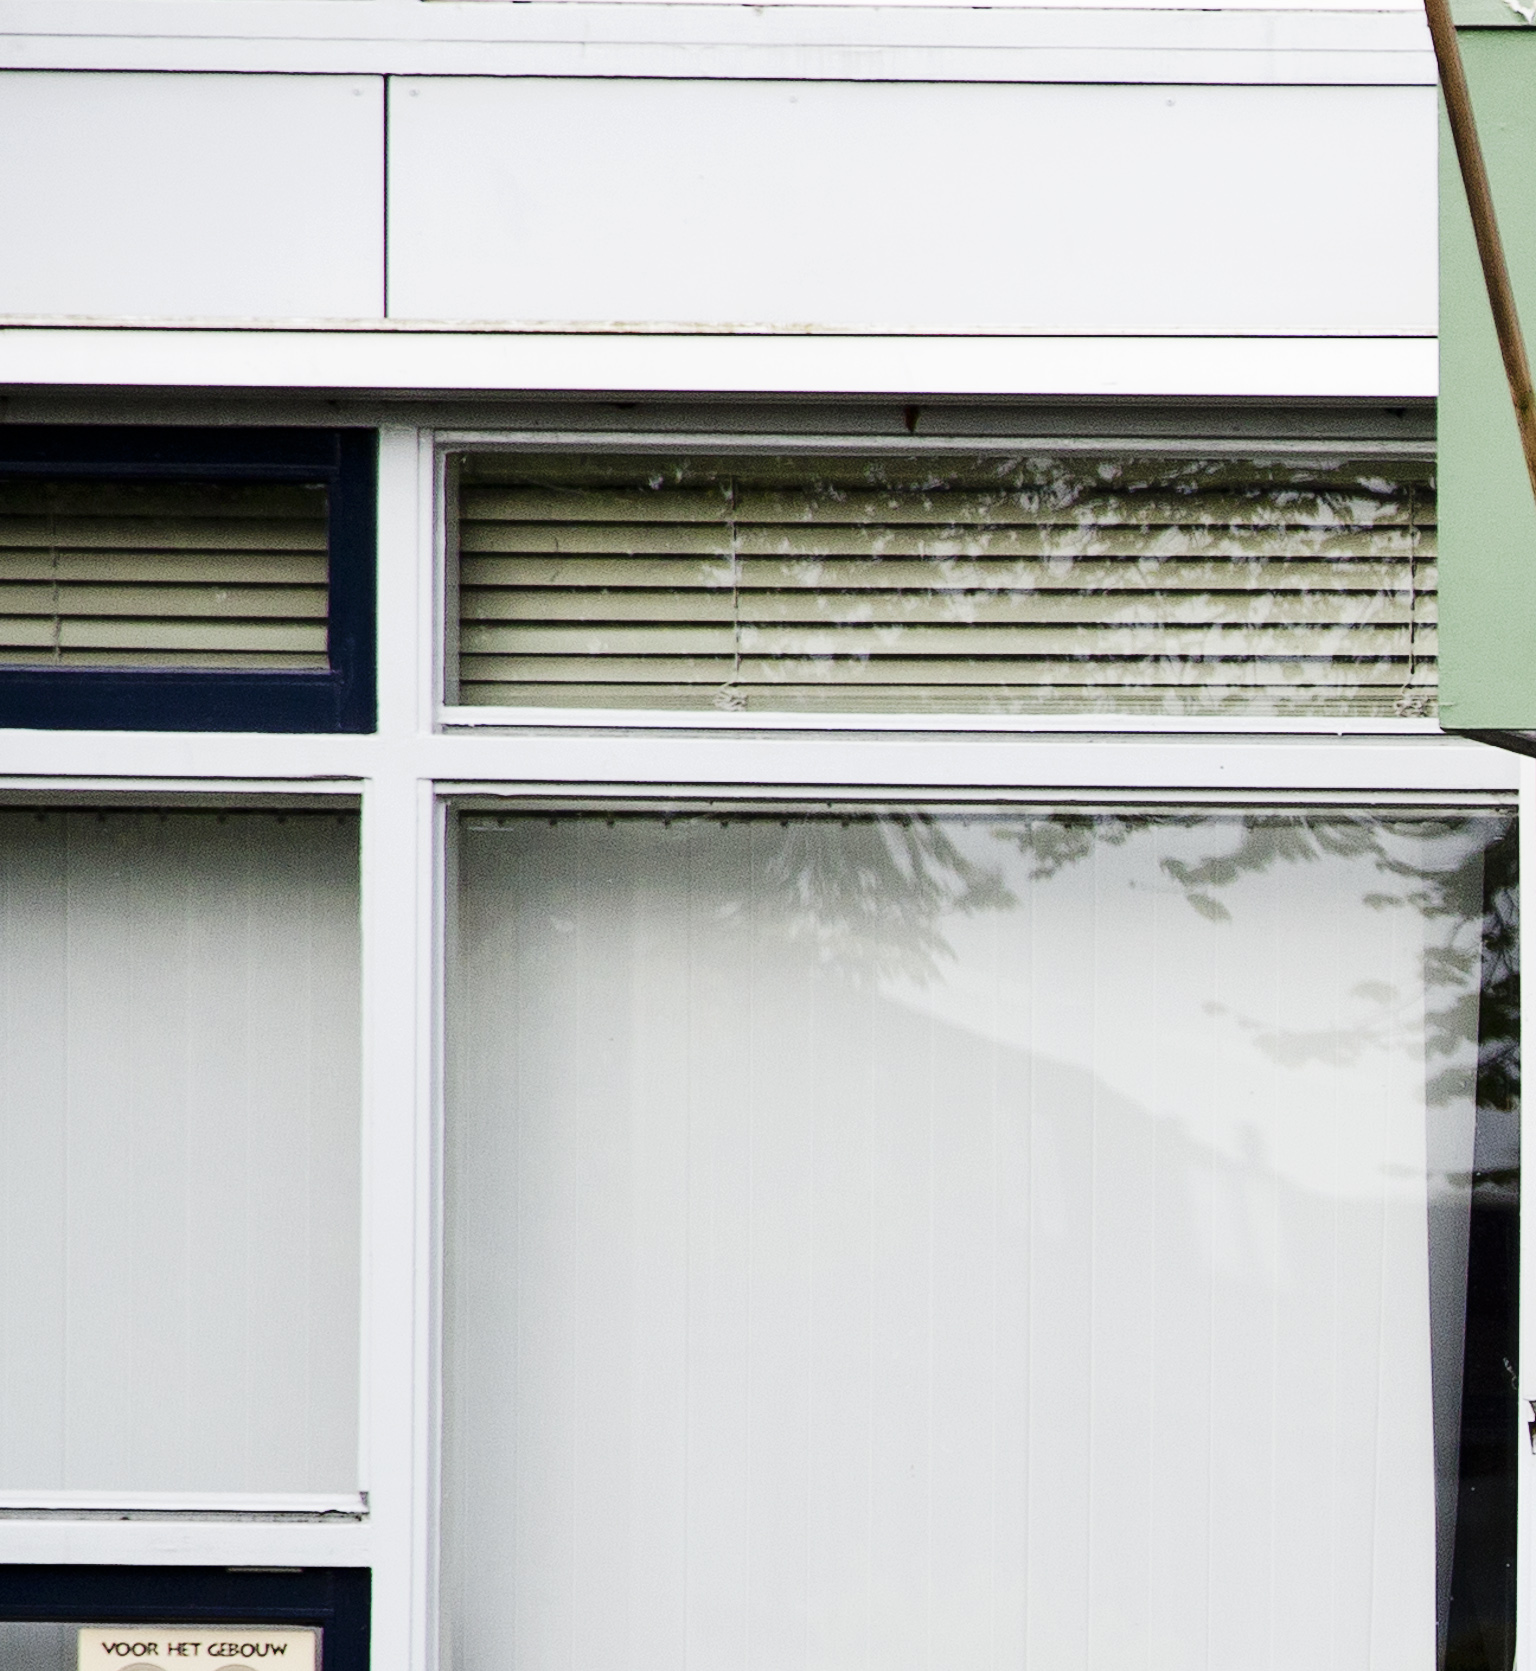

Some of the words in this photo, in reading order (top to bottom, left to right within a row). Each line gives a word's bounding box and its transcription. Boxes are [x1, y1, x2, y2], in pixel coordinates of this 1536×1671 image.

[102, 1642, 159, 1657] VOOR
[167, 1642, 202, 1657] HET
[207, 1643, 287, 1657] GEBOUW
